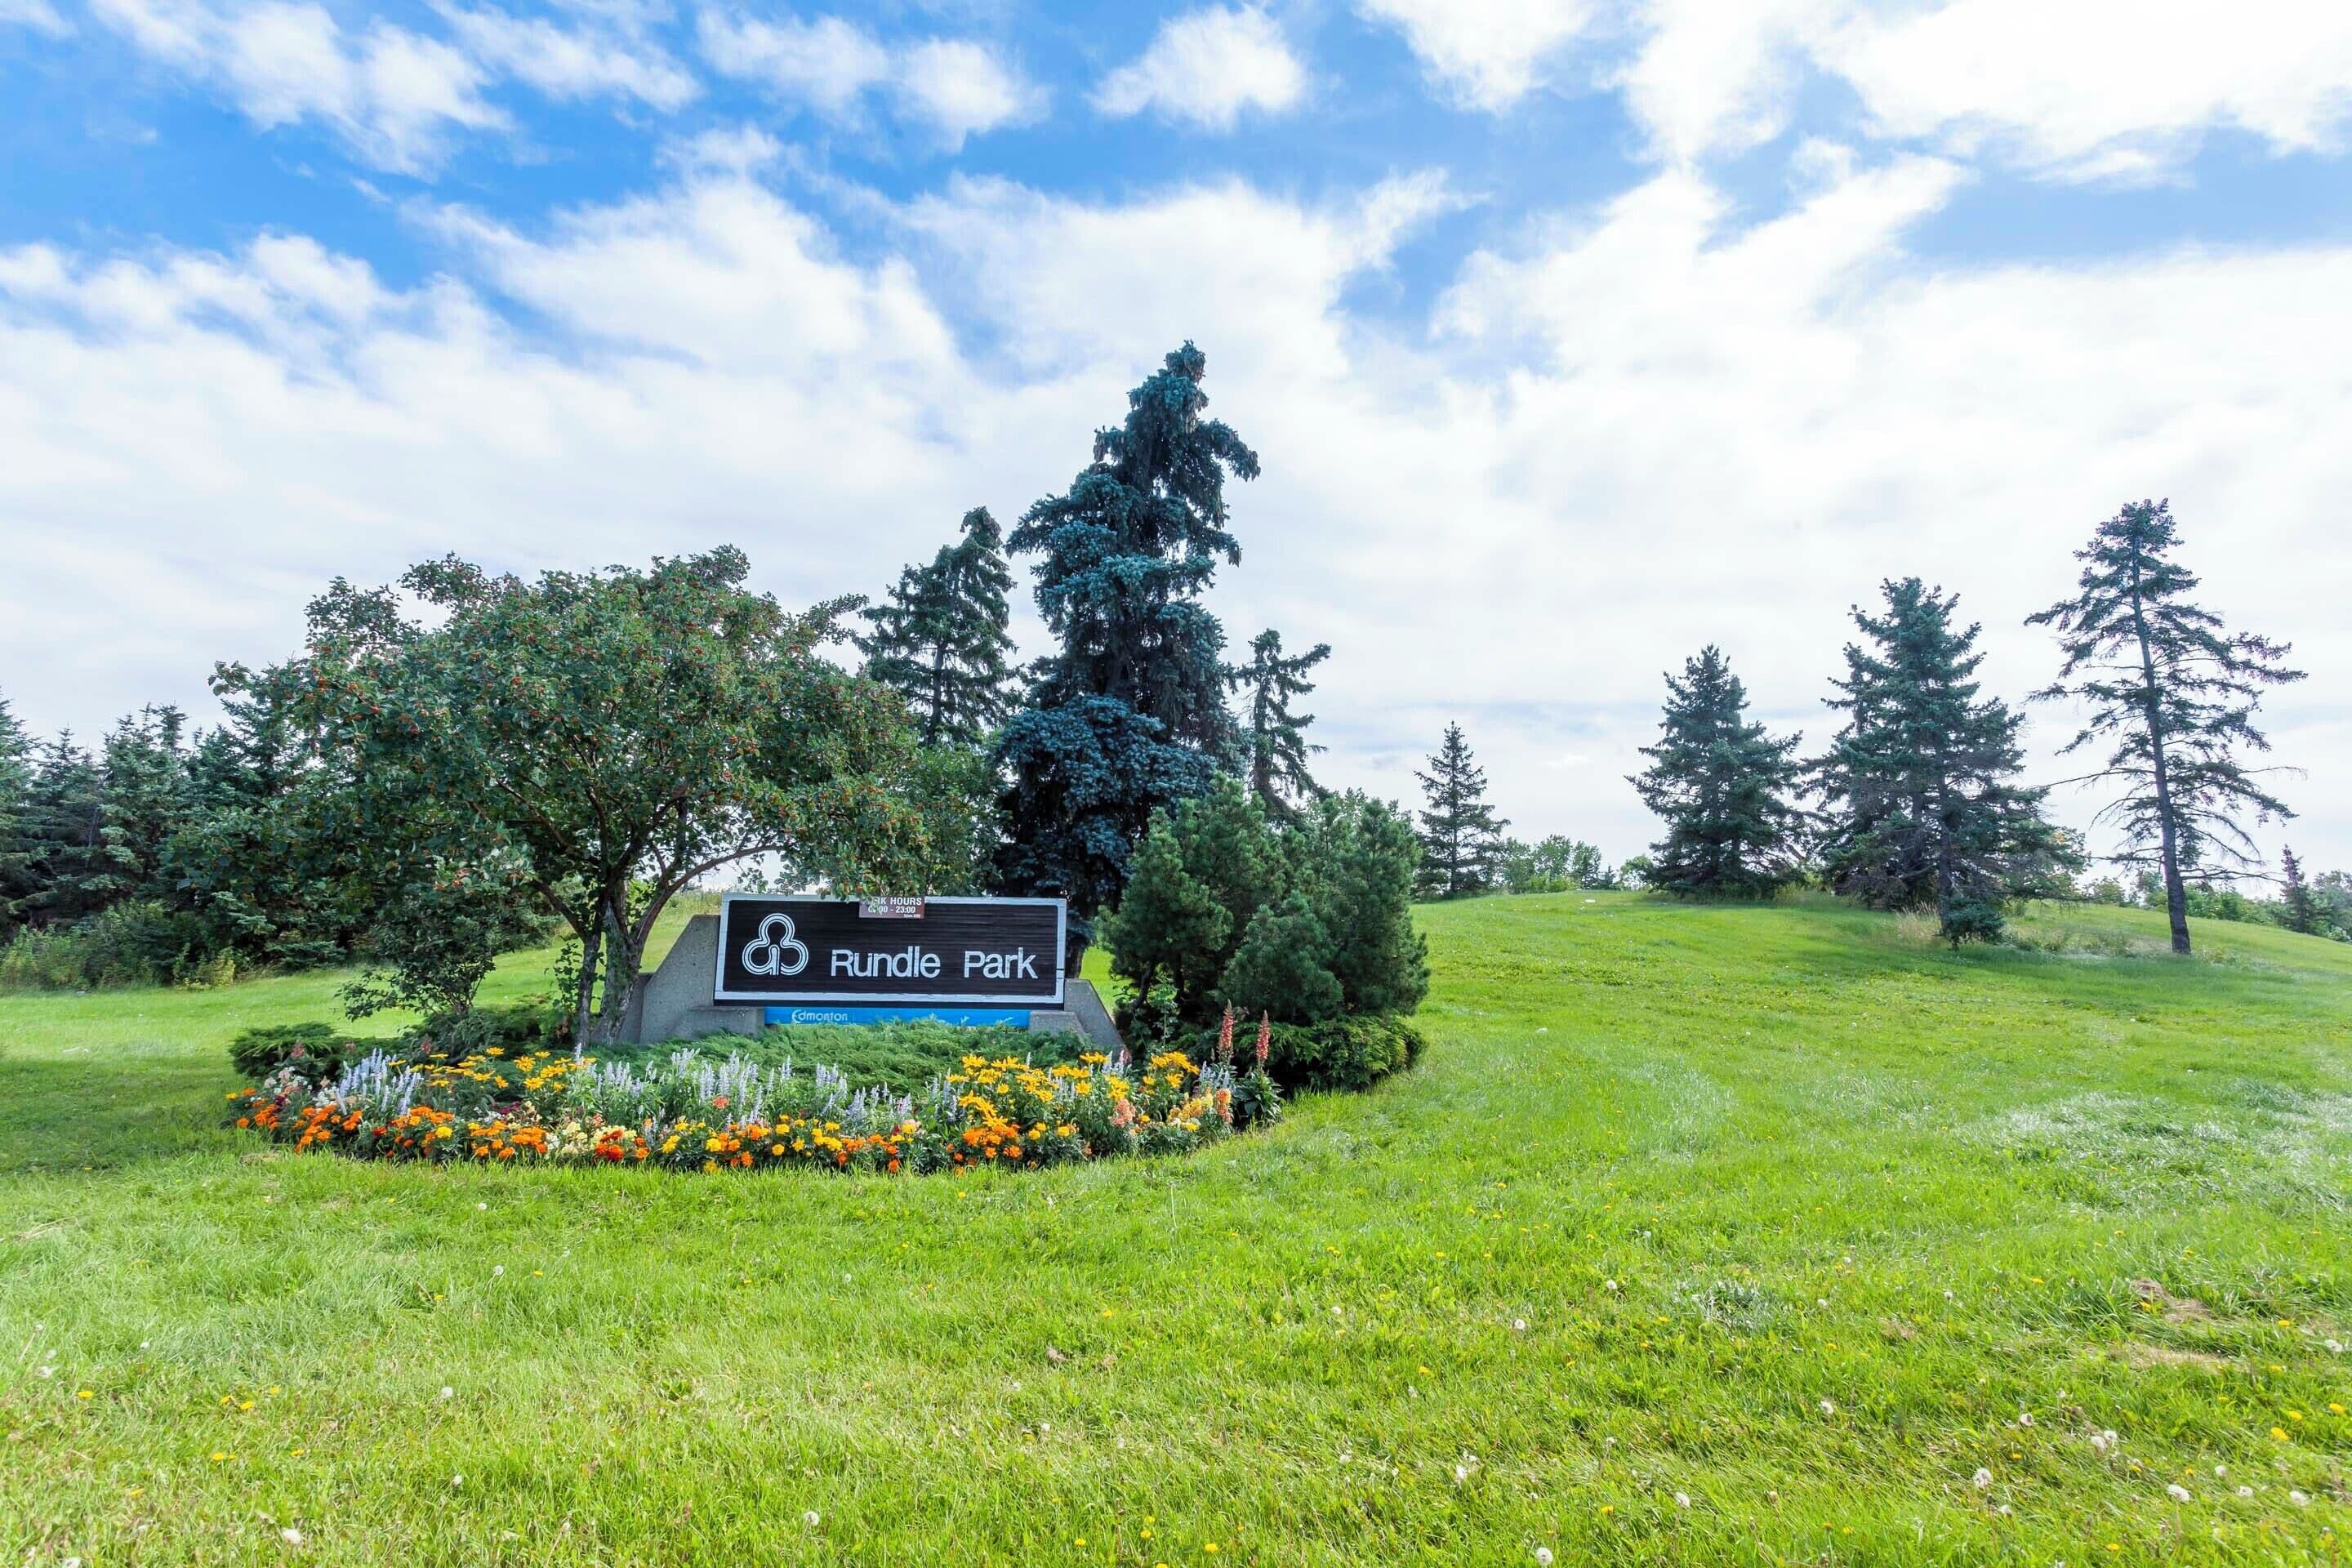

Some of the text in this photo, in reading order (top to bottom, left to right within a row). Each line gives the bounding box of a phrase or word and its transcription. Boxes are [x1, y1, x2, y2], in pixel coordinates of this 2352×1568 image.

[861, 897, 921, 906] RK HOURS
[896, 906, 915, 914] 23:00
[831, 947, 1038, 979] Rundle Park
[791, 1009, 849, 1023] Edmonton
